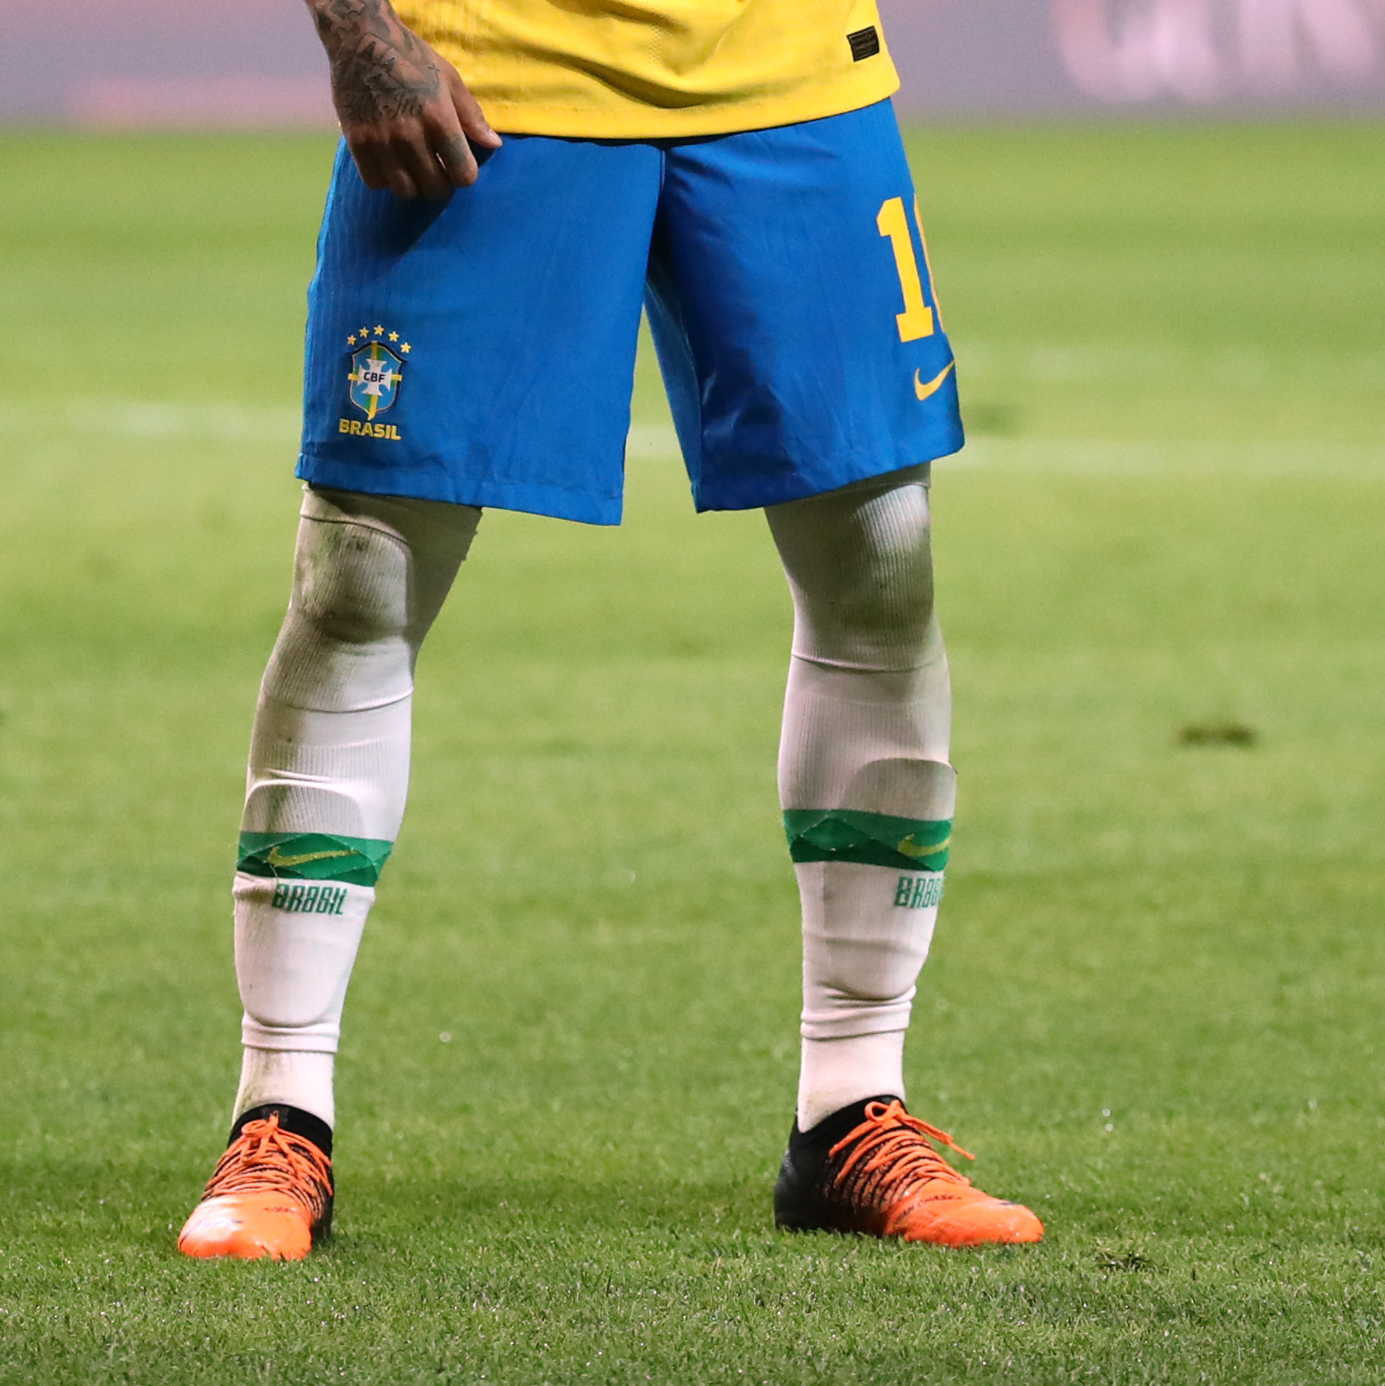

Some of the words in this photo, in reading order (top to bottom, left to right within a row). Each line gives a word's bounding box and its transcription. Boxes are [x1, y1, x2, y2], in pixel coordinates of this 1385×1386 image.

[876, 192, 945, 343] 1
[363, 371, 386, 383] CBF
[338, 418, 402, 441] BRASIL
